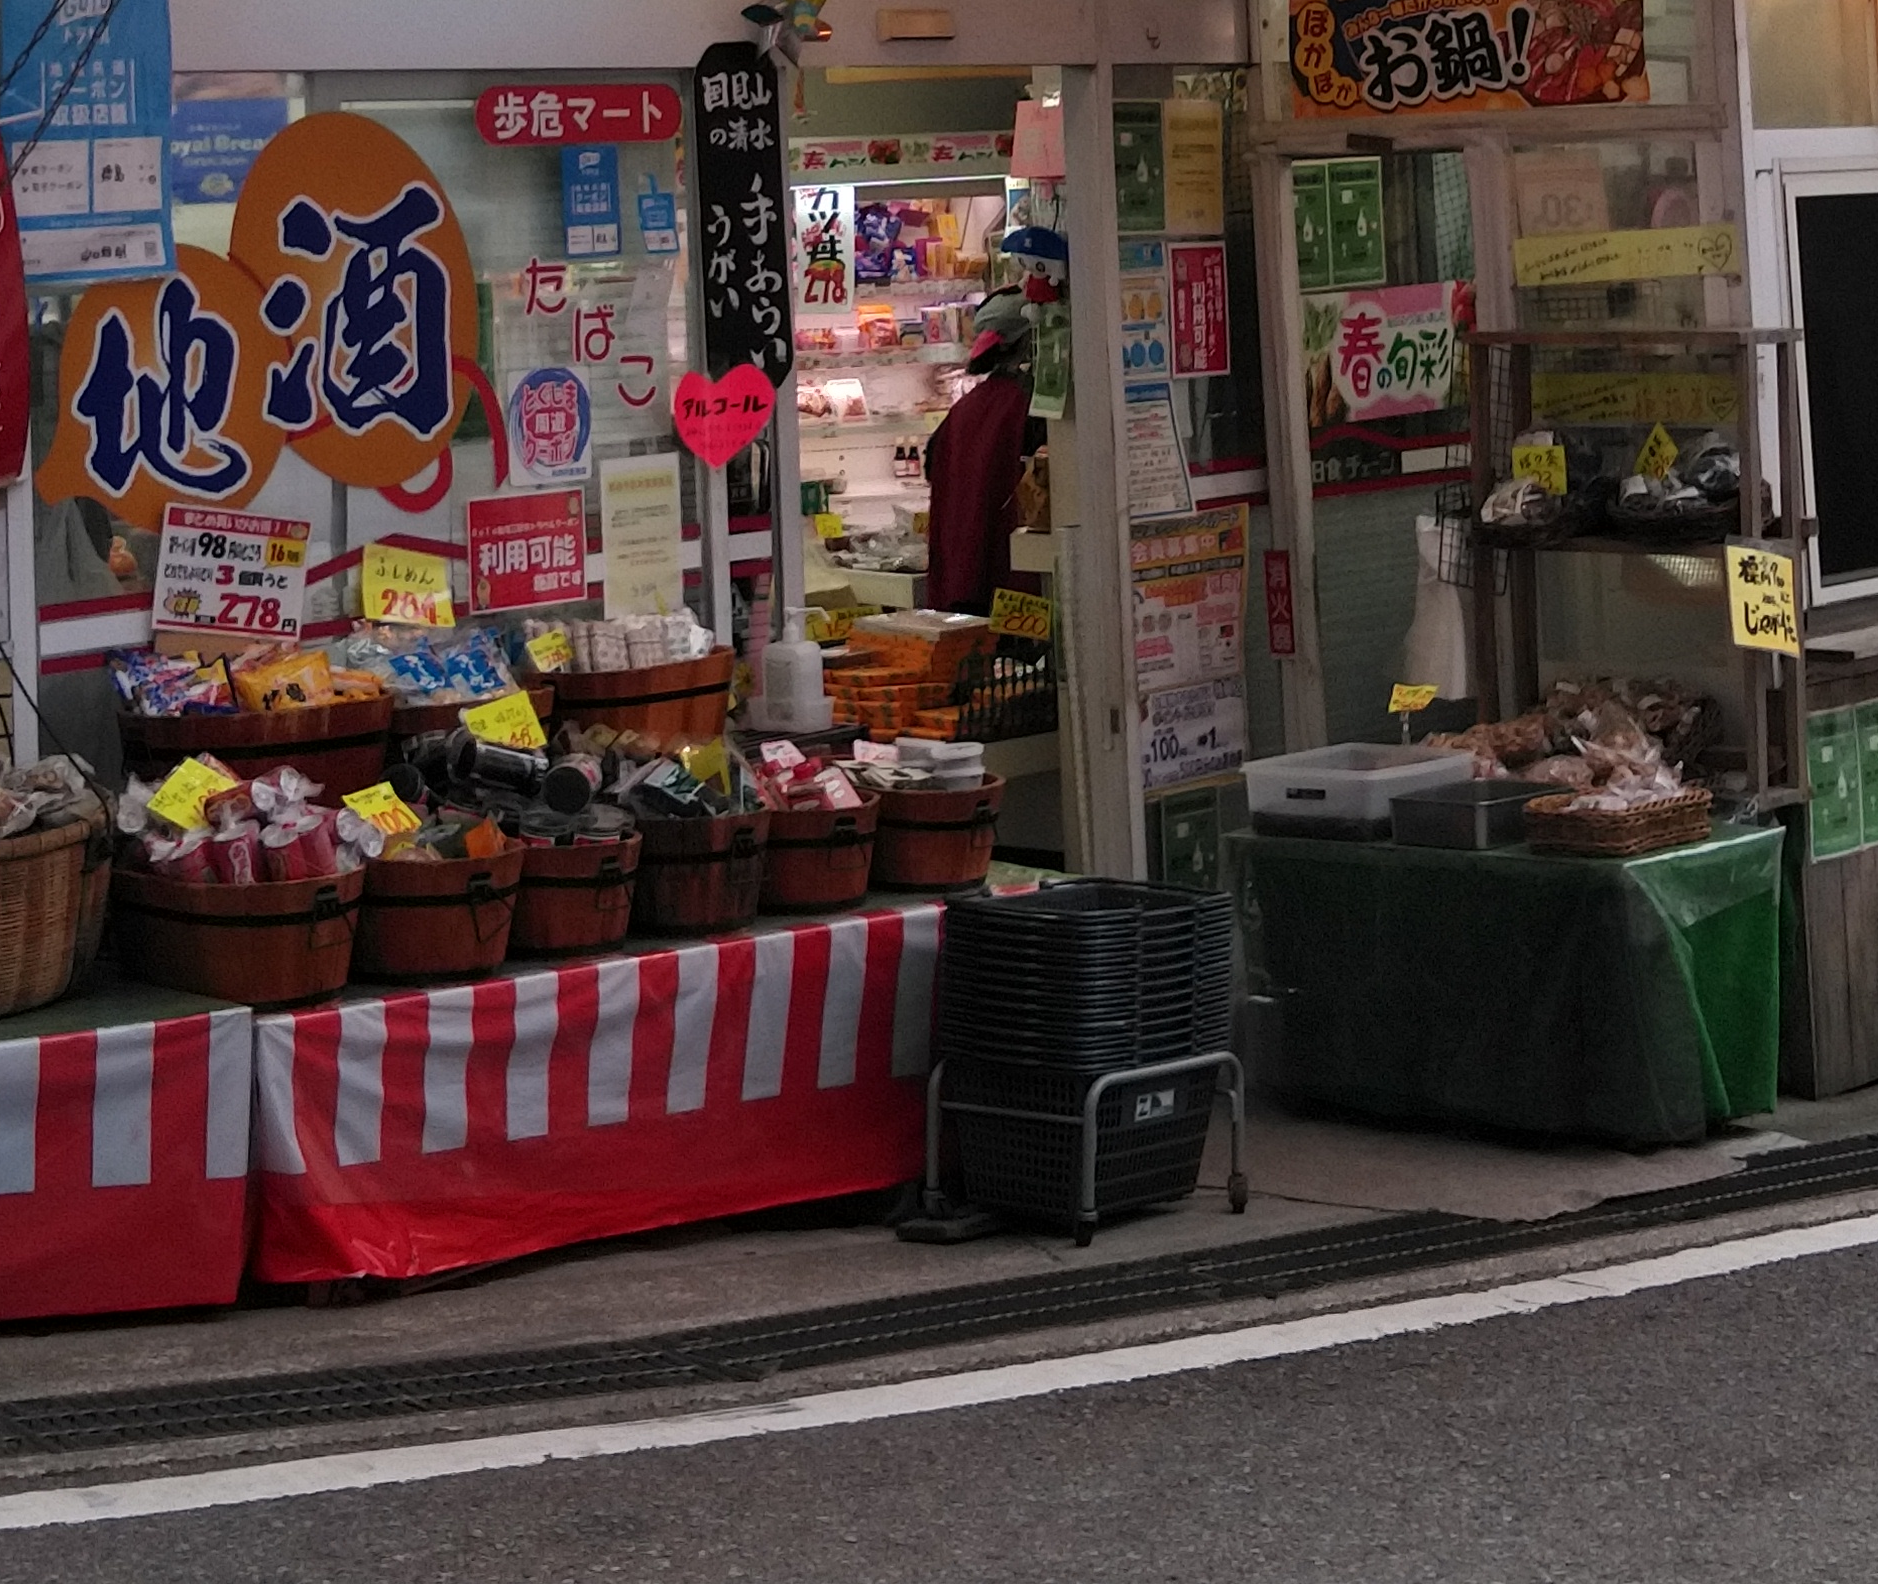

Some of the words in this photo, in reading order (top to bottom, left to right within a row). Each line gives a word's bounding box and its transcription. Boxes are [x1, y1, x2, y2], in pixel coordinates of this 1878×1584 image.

[493, 90, 663, 140] 歩危マート
[75, 182, 453, 497] 地酒
[525, 257, 657, 406] たばこ
[1338, 311, 1451, 399] 春の旬彩
[522, 379, 579, 415] とくしま
[681, 394, 770, 421] アルコール
[1311, 450, 1396, 484] 日食チェーン
[478, 535, 578, 577] 利用可能
